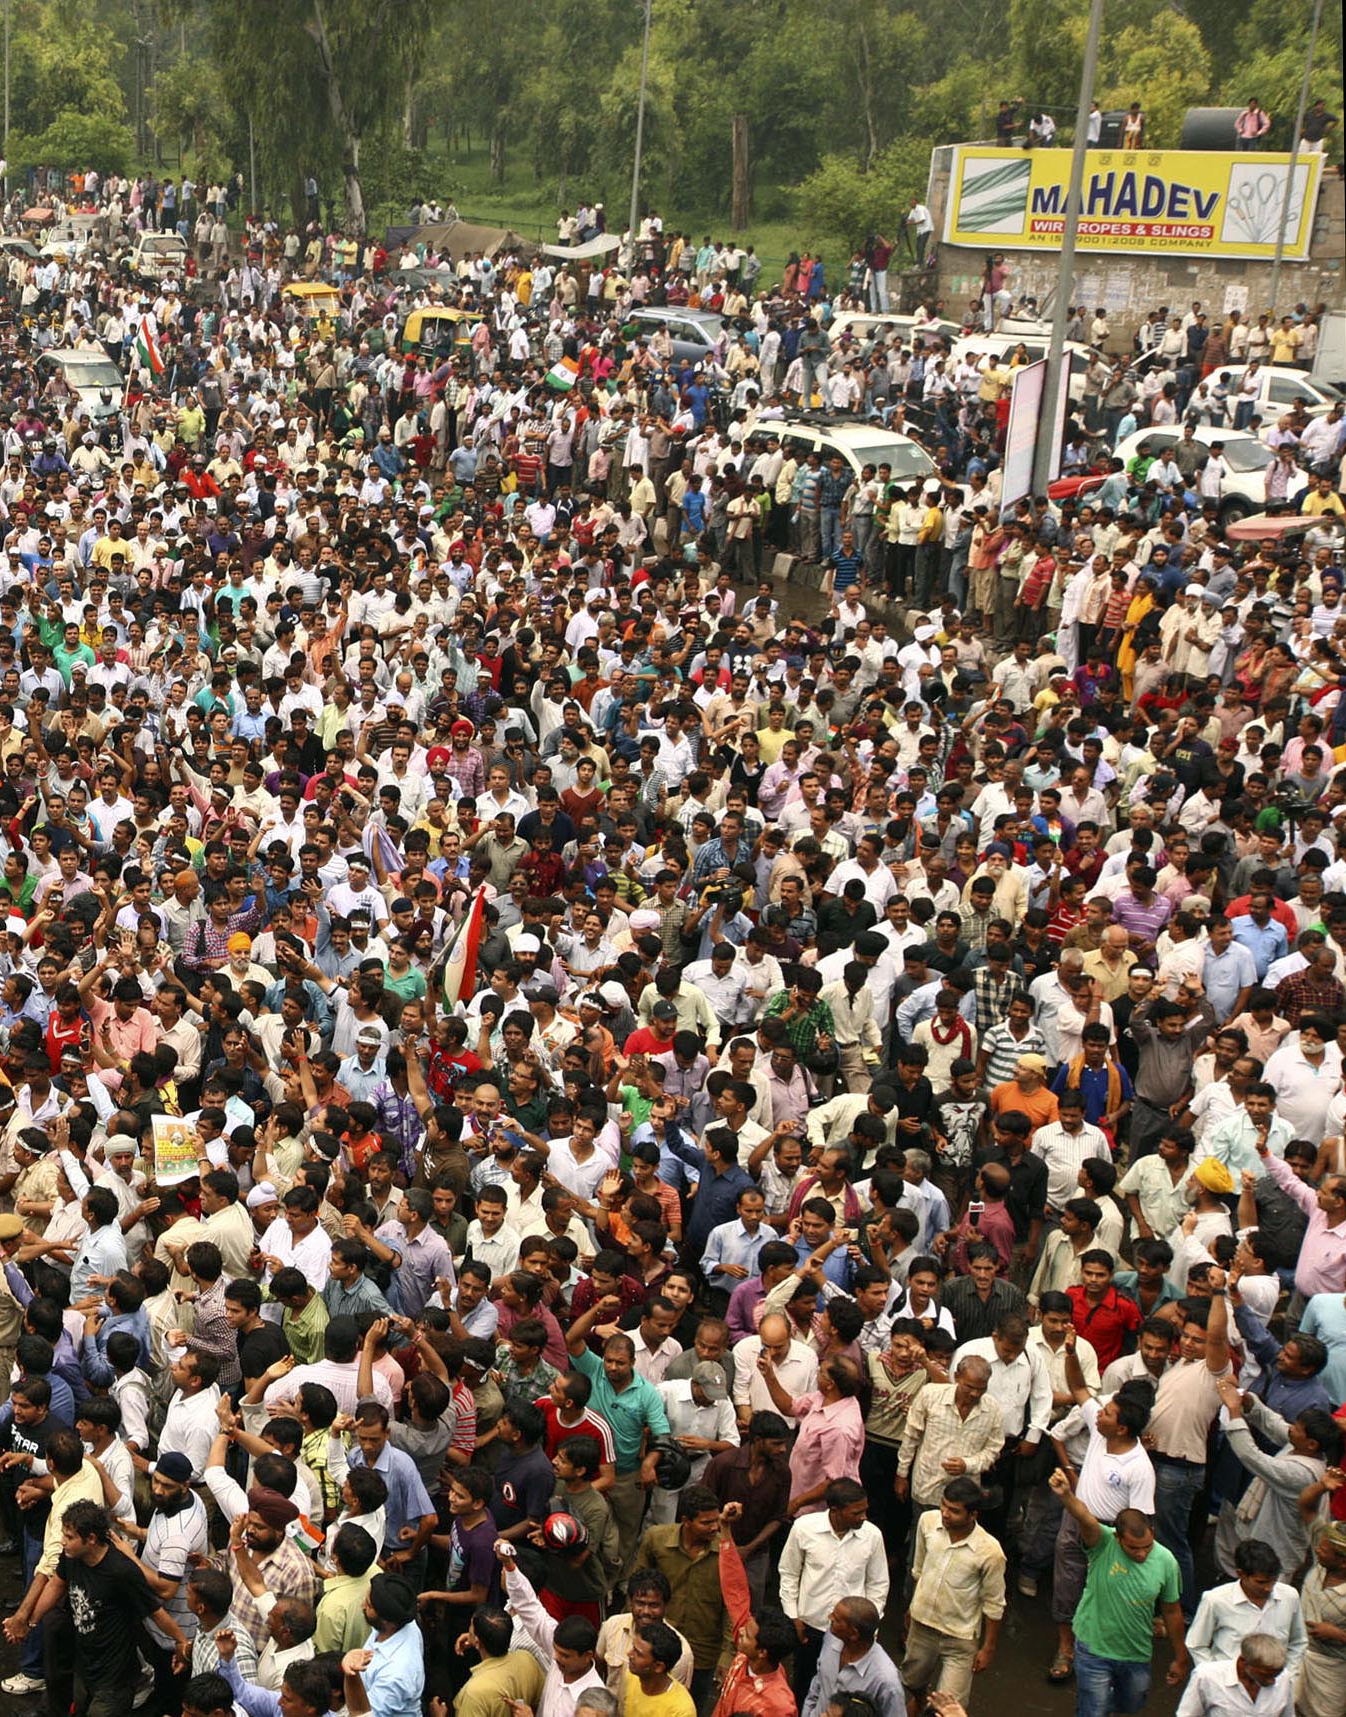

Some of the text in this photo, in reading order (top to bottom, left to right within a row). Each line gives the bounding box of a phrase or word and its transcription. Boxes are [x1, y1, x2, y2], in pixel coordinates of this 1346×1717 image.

[1032, 220, 1212, 238] WIR ROPES & SLINGS
[1028, 234, 1046, 242] AN
[1149, 238, 1213, 249] COMPANY
